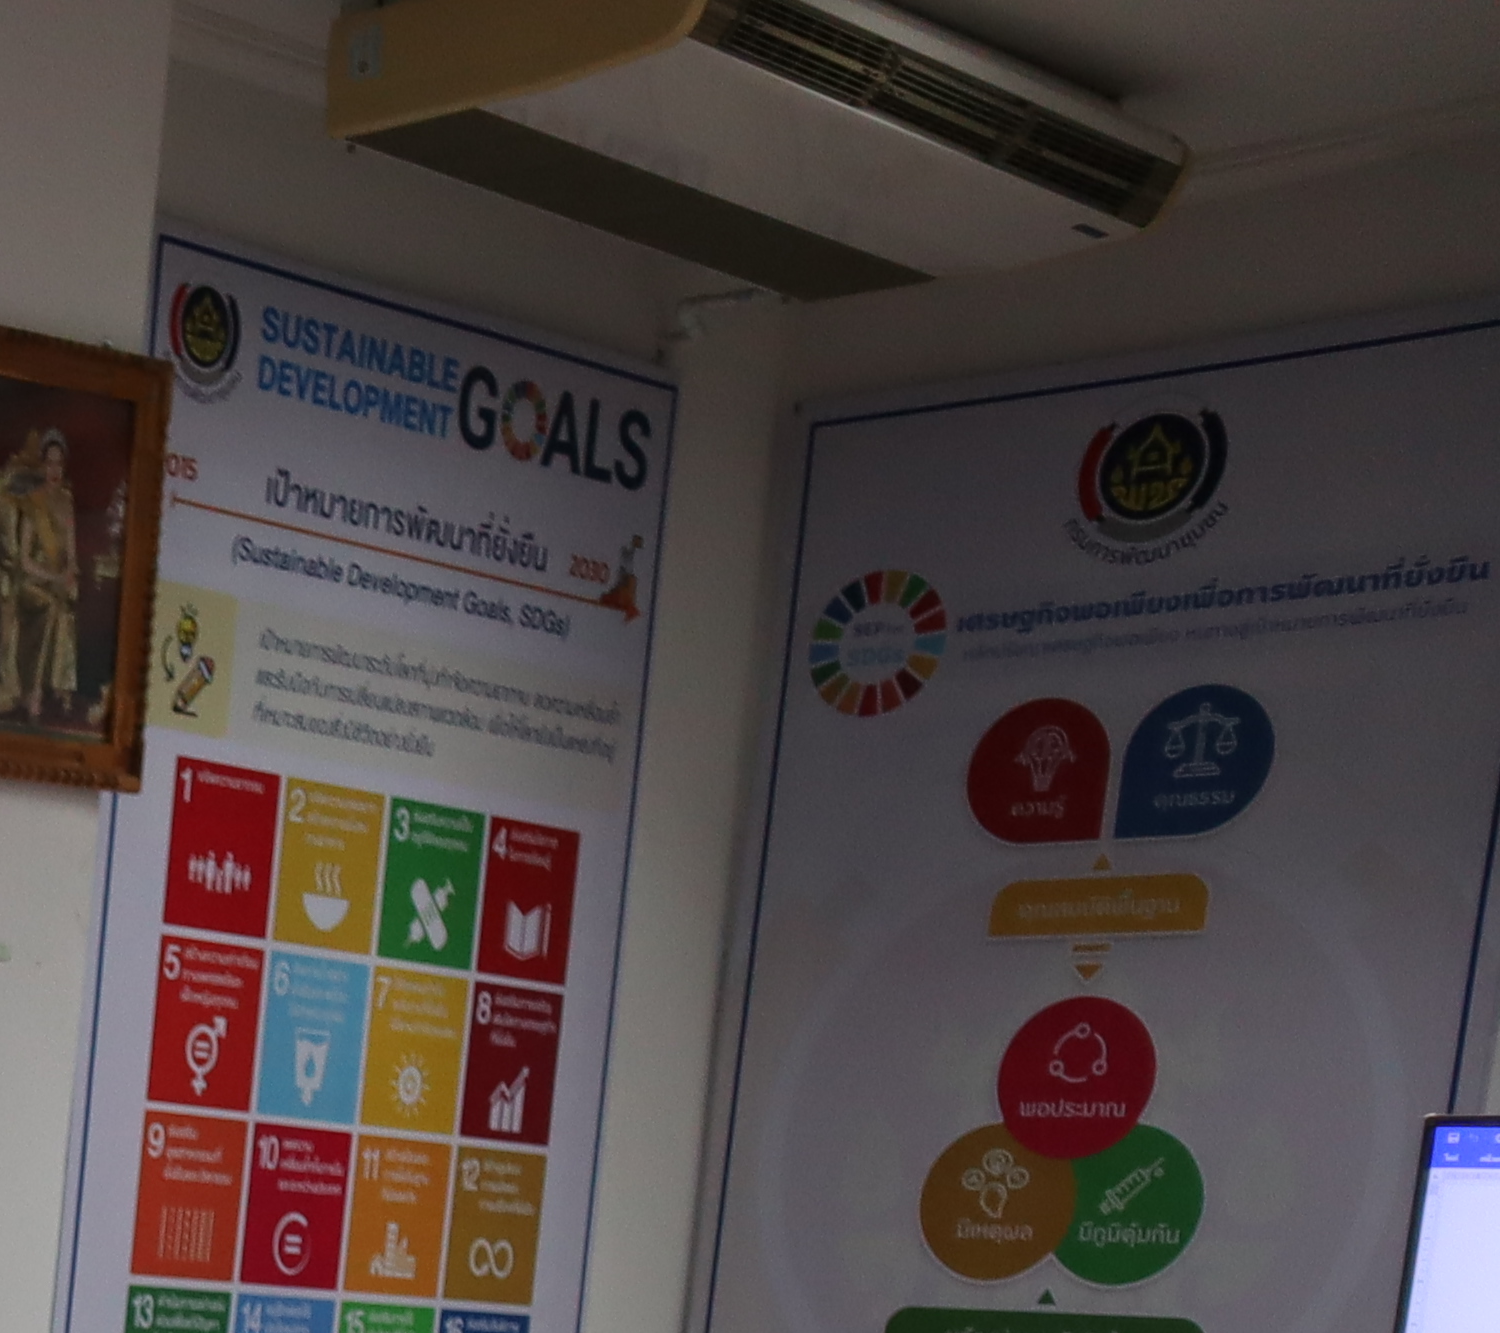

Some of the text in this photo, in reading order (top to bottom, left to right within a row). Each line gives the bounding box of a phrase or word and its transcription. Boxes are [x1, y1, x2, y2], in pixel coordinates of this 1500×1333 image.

[262, 306, 460, 394] SUSTAINABLE
[257, 356, 454, 439] DEVELOPMENT
[458, 366, 652, 491] GOALS
[232, 534, 344, 583] (Sustainable
[347, 563, 460, 611] Development
[956, 554, 1490, 638] เศรษฐกิจพอเพียงเพื่อการพัฒนาที่ยั่งยืน
[179, 767, 195, 803] 1
[288, 789, 306, 823] 2
[394, 807, 411, 840] 3
[492, 828, 508, 860] 4
[162, 946, 181, 980] 5
[273, 961, 290, 996] 6
[374, 978, 390, 1010] 7
[474, 991, 492, 1025] 8
[1019, 1098, 1126, 1120] พอประมาณ
[146, 1121, 165, 1159] 9
[258, 1133, 280, 1171] 10
[361, 1147, 381, 1182] 11
[1078, 1222, 1181, 1250] มีภูมิคุ้มกัน
[132, 1294, 155, 1330] 13
